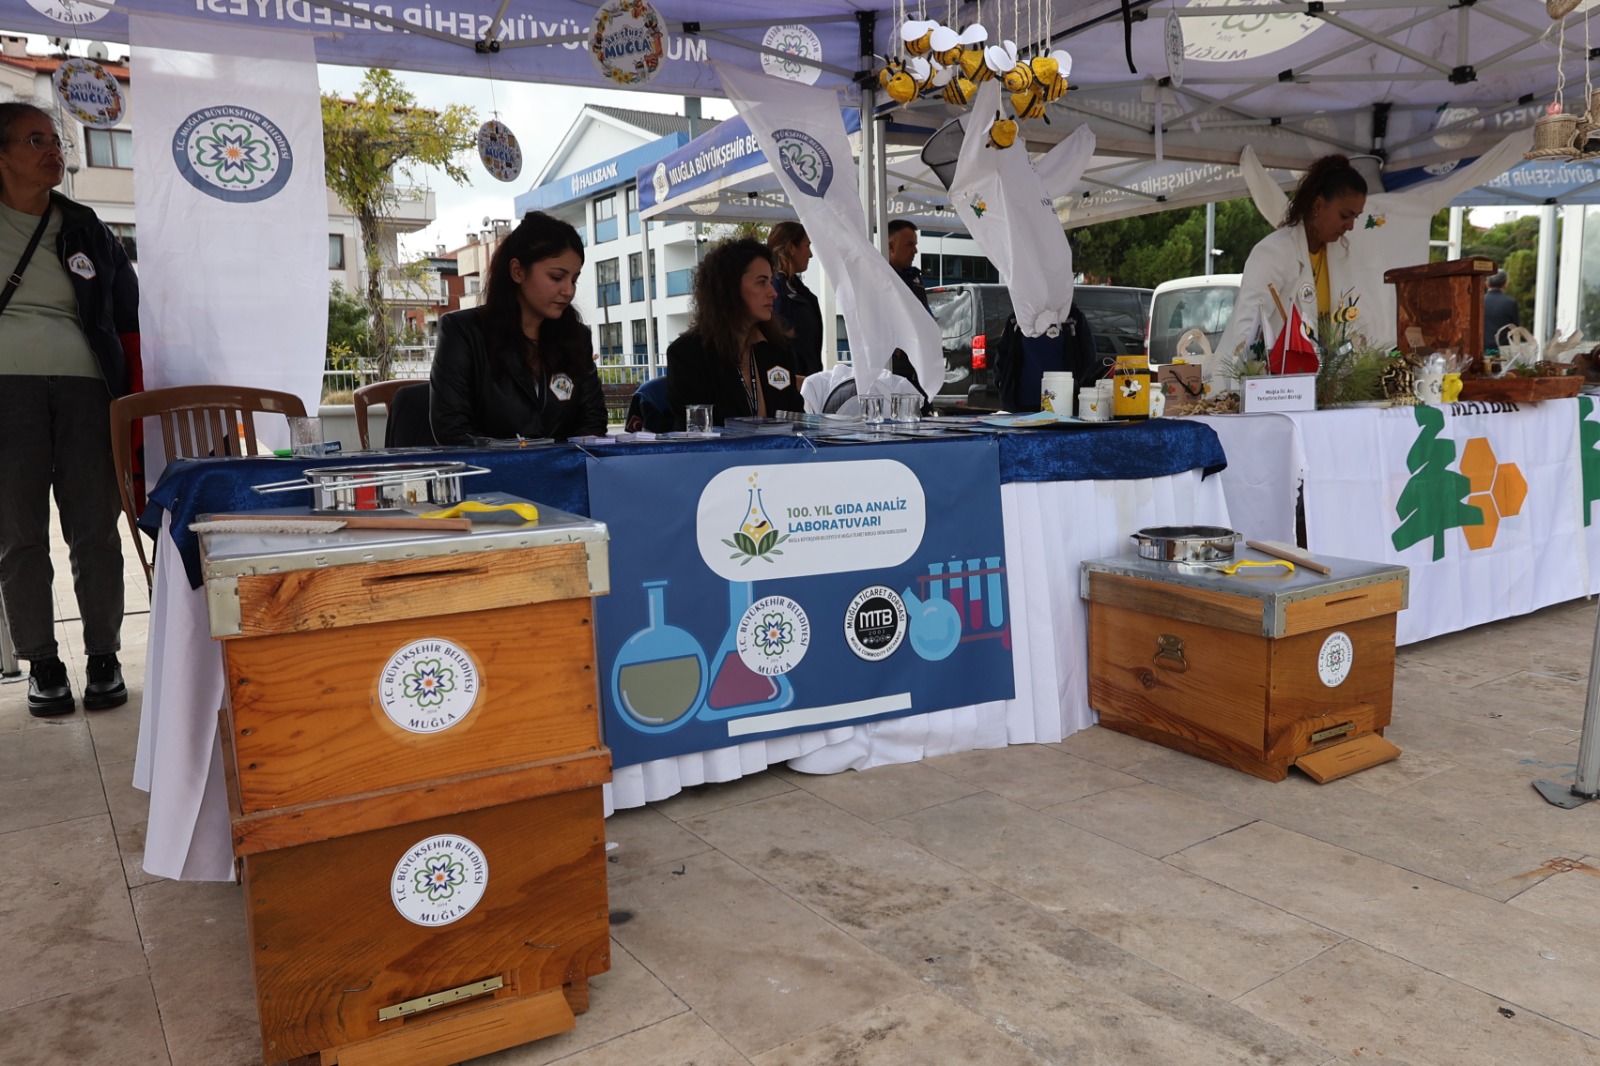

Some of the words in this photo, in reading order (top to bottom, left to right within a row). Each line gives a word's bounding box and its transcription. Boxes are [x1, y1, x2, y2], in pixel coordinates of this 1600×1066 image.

[604, 38, 651, 59] MUĞLA
[180, 113, 205, 138] MUĞLA
[204, 106, 261, 123] BÜYÜKŞEHİR
[261, 120, 291, 160] BELEDİYESİ
[668, 163, 695, 186] MUĞLA
[695, 136, 746, 173] BÜYÜKŞEHİR
[579, 161, 619, 190] HALKBANK
[787, 507, 812, 519] 100.
[814, 505, 833, 516] YIL
[834, 503, 863, 515] GIDA
[865, 496, 907, 513] ANALİZ
[788, 516, 881, 533] LABORATUVARI
[740, 597, 785, 633] BÜYÜKŞEHİR
[847, 600, 860, 629] MUĞLA
[858, 588, 888, 602] TİCARET
[887, 591, 905, 622] BORSASI
[860, 608, 893, 629] MTB
[786, 601, 809, 647] BELEDİYESİ
[738, 636, 748, 654] T.C.
[385, 643, 442, 684] BÜYÜKŞEHİR
[443, 647, 474, 694] BELEDİYESİ
[757, 662, 792, 675] MUĞLA
[384, 688, 395, 706] T.C.
[408, 712, 456, 729] MUĞLA
[397, 839, 453, 881] BÜYÜKŞEHİR
[454, 842, 483, 885] BELEDİYESİ
[396, 884, 407, 903] T.C.
[419, 904, 466, 922] MUĞLA
